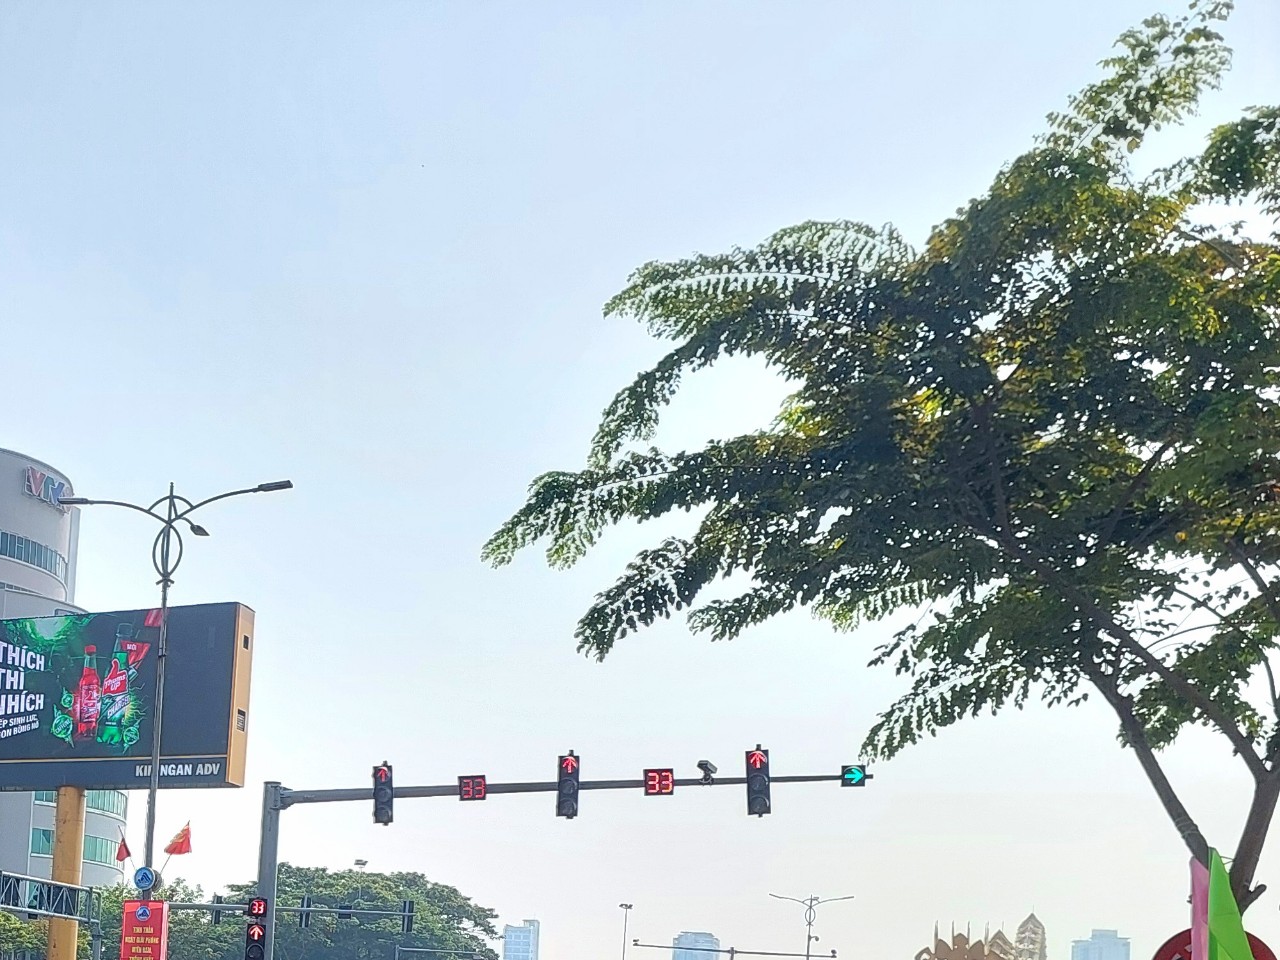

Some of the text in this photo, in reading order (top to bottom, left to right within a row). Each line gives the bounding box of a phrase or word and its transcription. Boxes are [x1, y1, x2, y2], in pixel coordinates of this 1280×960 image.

[160, 764, 192, 776] NGAN
[196, 763, 220, 776] ADV
[462, 779, 485, 798] 33
[648, 772, 672, 793] 33
[251, 901, 265, 914] 33
